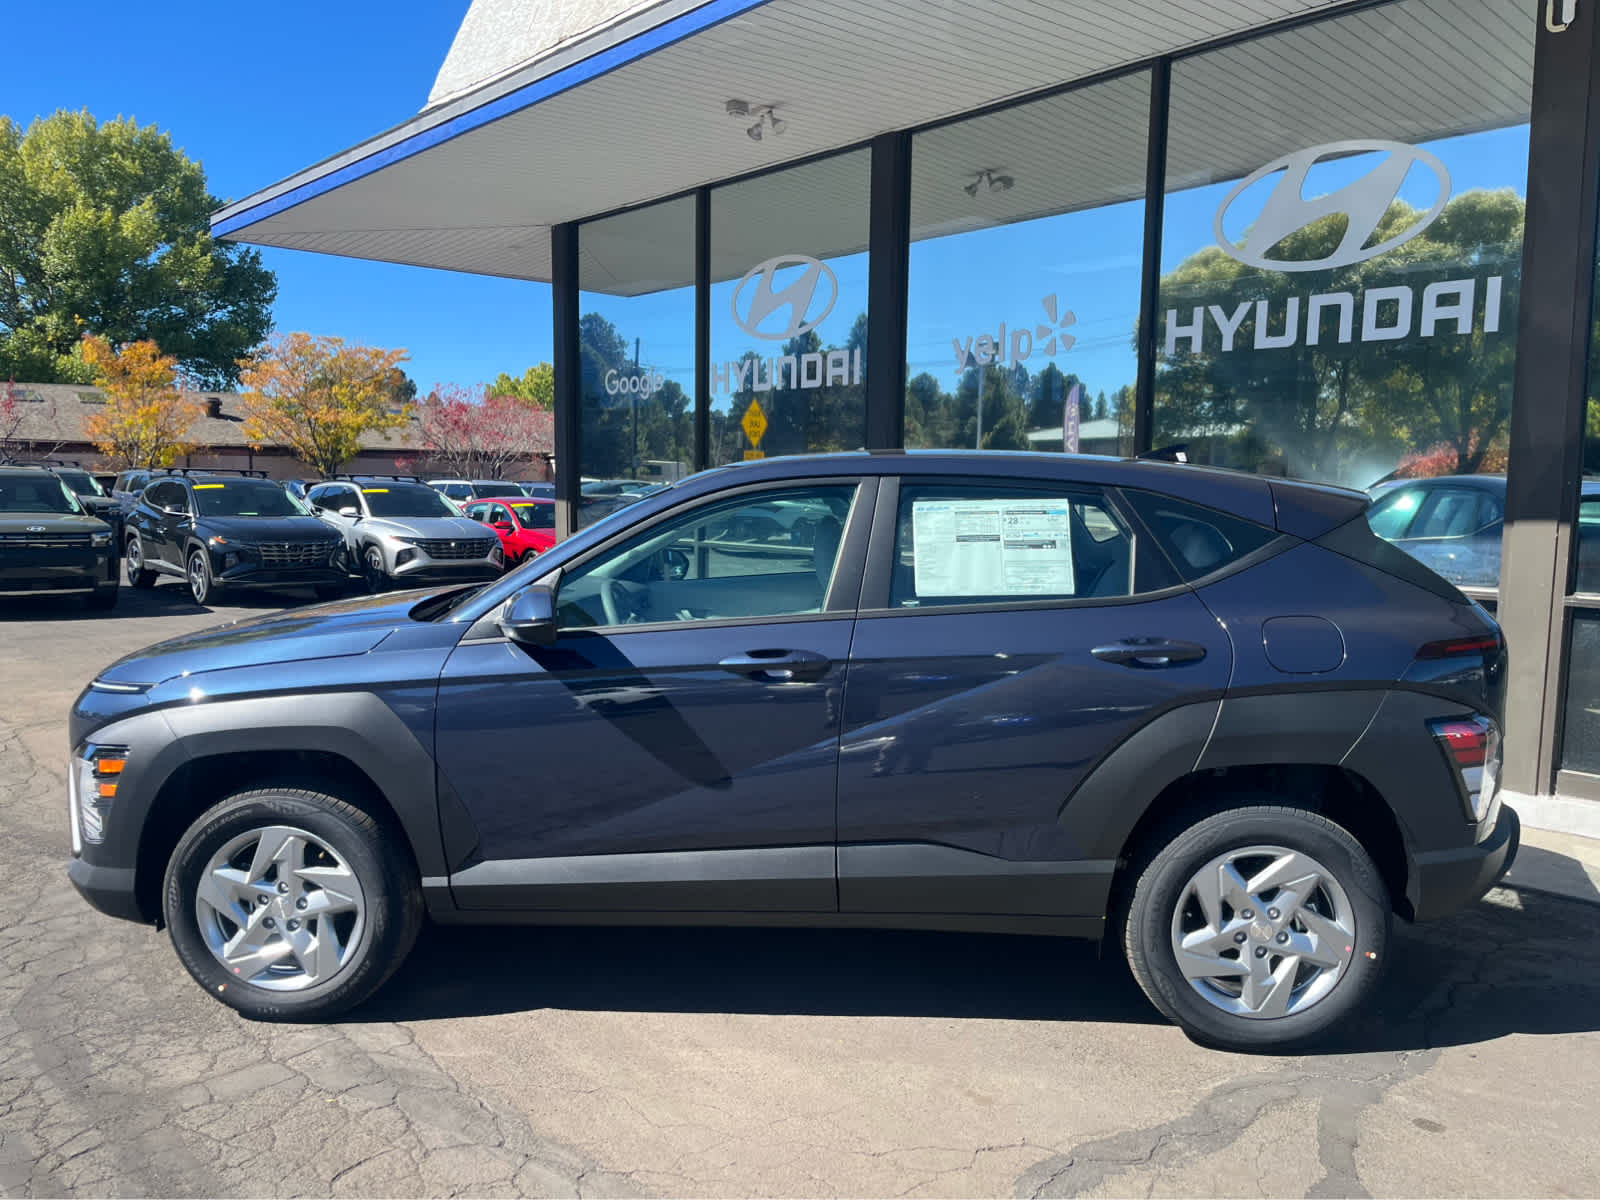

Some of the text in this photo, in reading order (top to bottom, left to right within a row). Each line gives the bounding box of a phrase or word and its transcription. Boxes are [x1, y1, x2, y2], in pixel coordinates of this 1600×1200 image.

[1164, 276, 1502, 356] HYUNDAI
[712, 345, 861, 394] HYUNDAI
[953, 321, 1032, 374] yelp
[605, 365, 664, 400] Google
